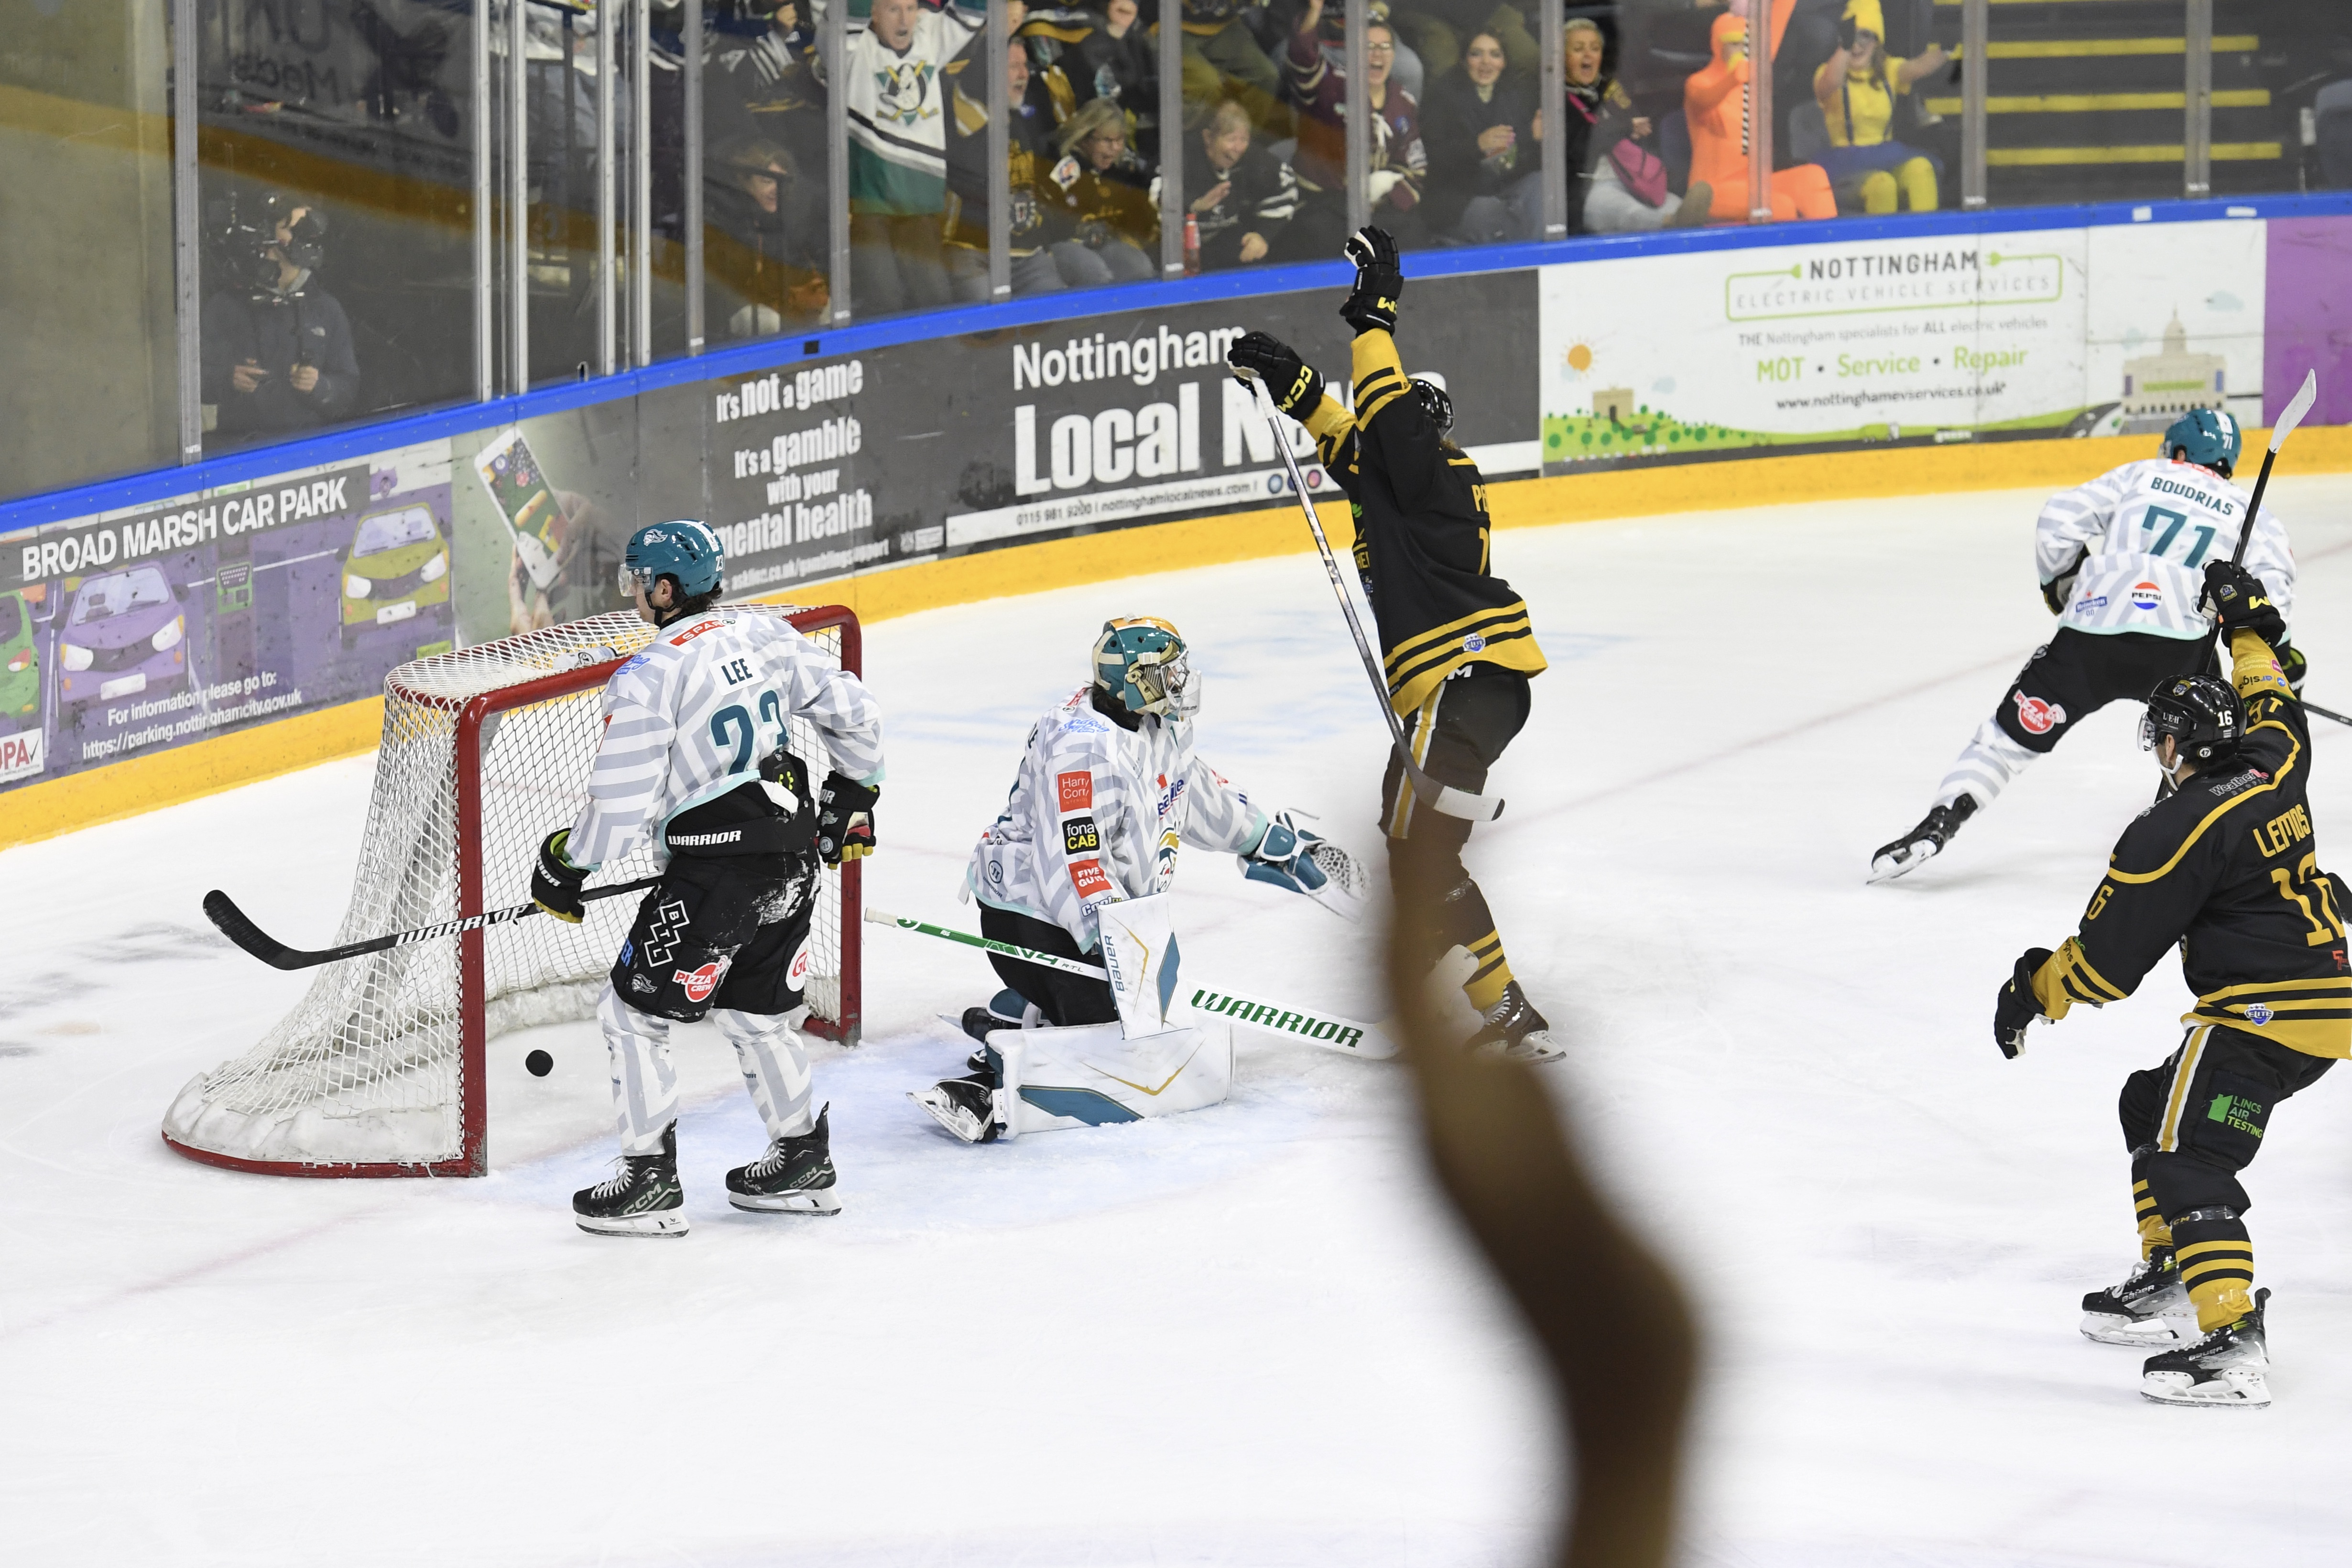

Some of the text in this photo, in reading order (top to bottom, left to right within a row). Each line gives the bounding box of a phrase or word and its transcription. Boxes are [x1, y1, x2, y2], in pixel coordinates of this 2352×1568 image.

[1810, 250, 1978, 280] NOTTINGHAM
[1737, 274, 2049, 309] ELECTRIC VEHICLE SERVICES
[1740, 315, 2048, 346] THE Nottingham specialists for ALL electric vehicles
[1013, 325, 1246, 392] Nottingham
[1757, 344, 2029, 381] MOT Service Repair
[716, 359, 863, 423] It's not a game
[735, 414, 862, 479] It's a gamble
[1014, 381, 1199, 496] Local
[766, 468, 840, 505] with your
[2151, 477, 2234, 515] BOUDRIAS
[23, 476, 348, 582] BROAD MARSH CAR PARK
[718, 488, 873, 559] mental health
[1016, 510, 1041, 526] 0115
[2142, 504, 2217, 569] 71
[715, 554, 724, 572] 23
[2132, 590, 2162, 601] PEPSI
[682, 620, 724, 641] SPAR
[721, 658, 753, 686] LEE
[108, 671, 277, 727] For information please go to:
[2015, 693, 2046, 724] PIZZA
[2217, 710, 2233, 727] 16
[1062, 777, 1089, 789] Harry
[668, 829, 742, 846] WARRIOR
[1066, 823, 1095, 837] fona
[1067, 834, 1097, 849] CAB
[2253, 803, 2311, 858] LEMOS
[1078, 866, 1100, 878] FIVE
[1061, 962, 1084, 973] RTL
[1105, 935, 1125, 992] BAUER
[675, 972, 712, 985] PIZZA
[690, 983, 713, 992] CREW
[1191, 989, 1364, 1048] WARRIOR
[2248, 1009, 2272, 1019] ELITE
[2229, 1107, 2250, 1121] AIR
[2232, 1095, 2262, 1115] LINCS
[2227, 1115, 2264, 1139] TESTING
[789, 1166, 818, 1189] CCM
[624, 1183, 663, 1217] CCM
[2188, 1345, 2224, 1361] BAUER
